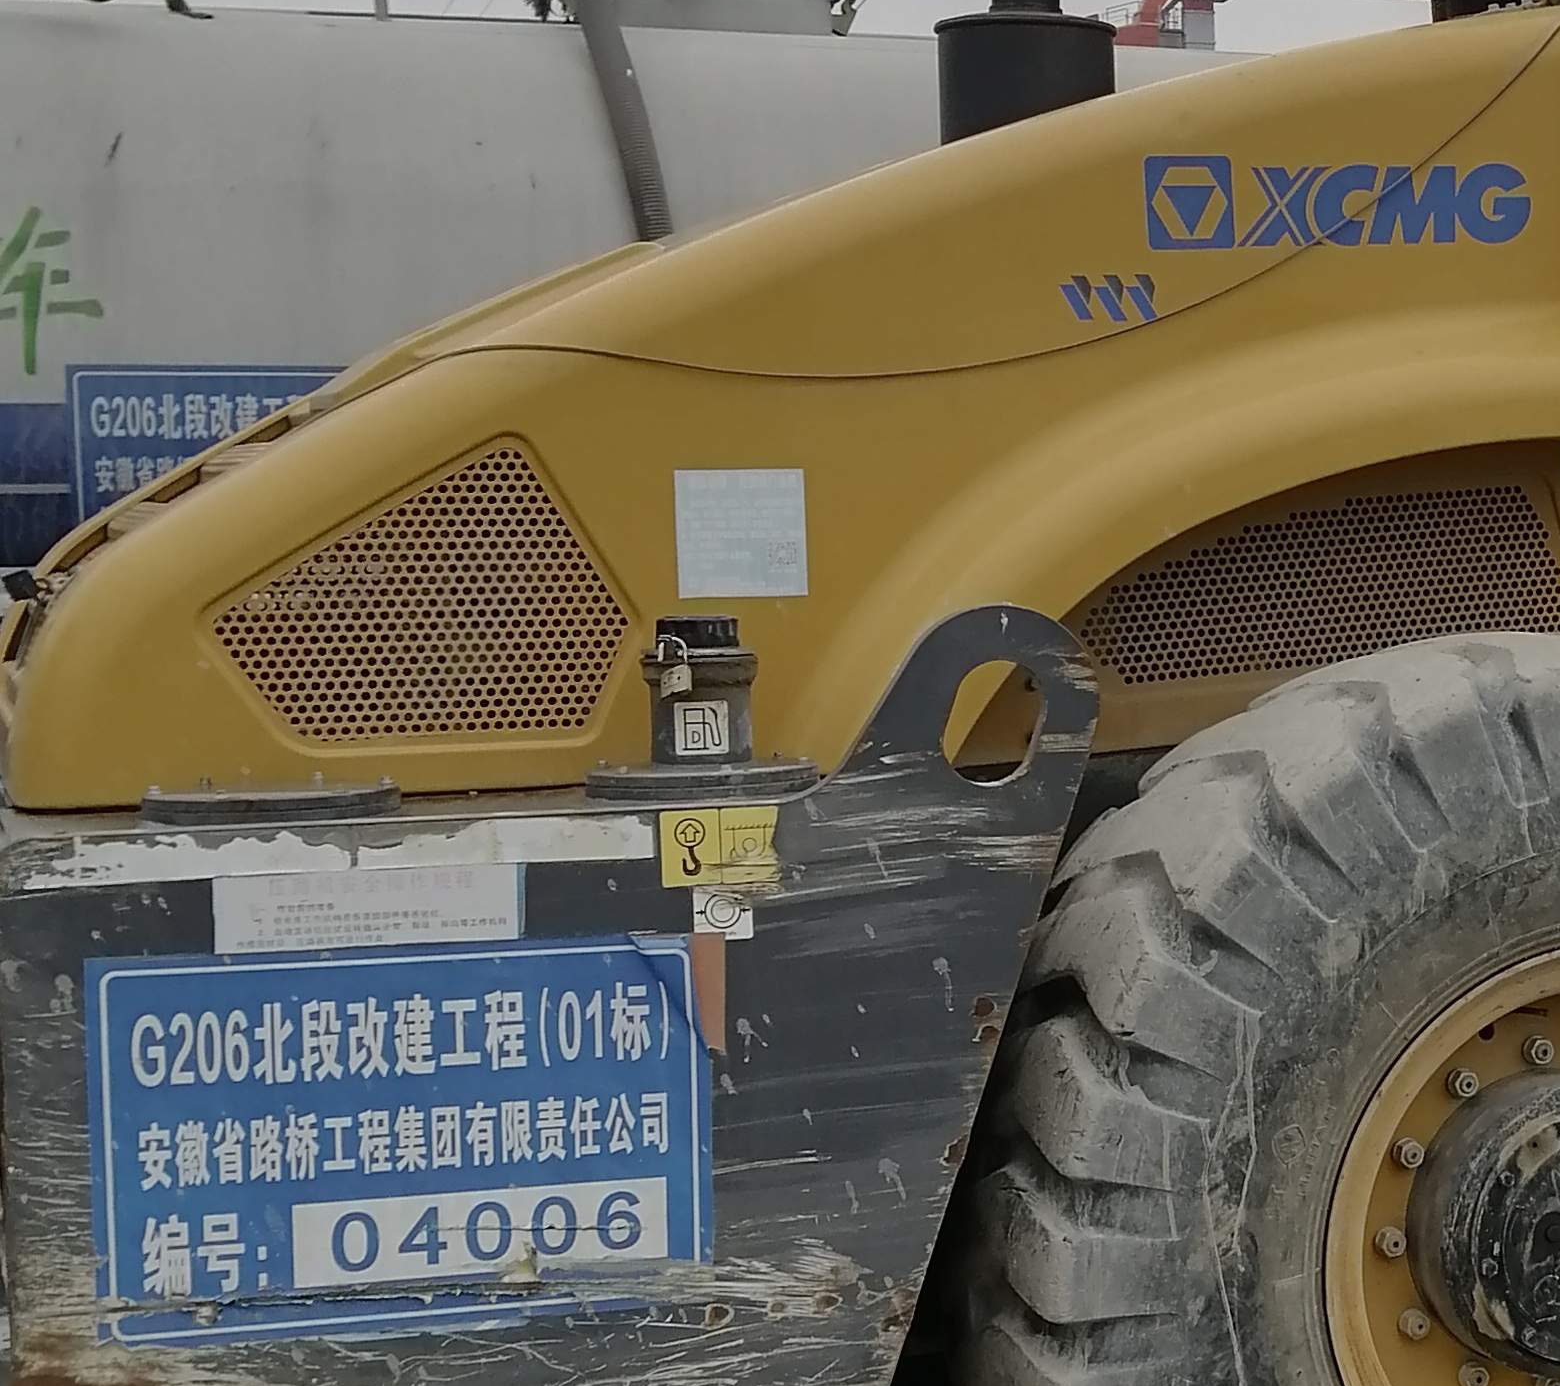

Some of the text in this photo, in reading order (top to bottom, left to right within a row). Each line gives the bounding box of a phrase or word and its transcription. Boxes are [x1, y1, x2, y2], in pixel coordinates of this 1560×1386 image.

[1237, 163, 1532, 247] XCMG
[91, 393, 305, 440] G206北段改建
[138, 1093, 670, 1193] 安徽省路桥工程集团有限责任公司
[331, 1191, 642, 1274] 04006
